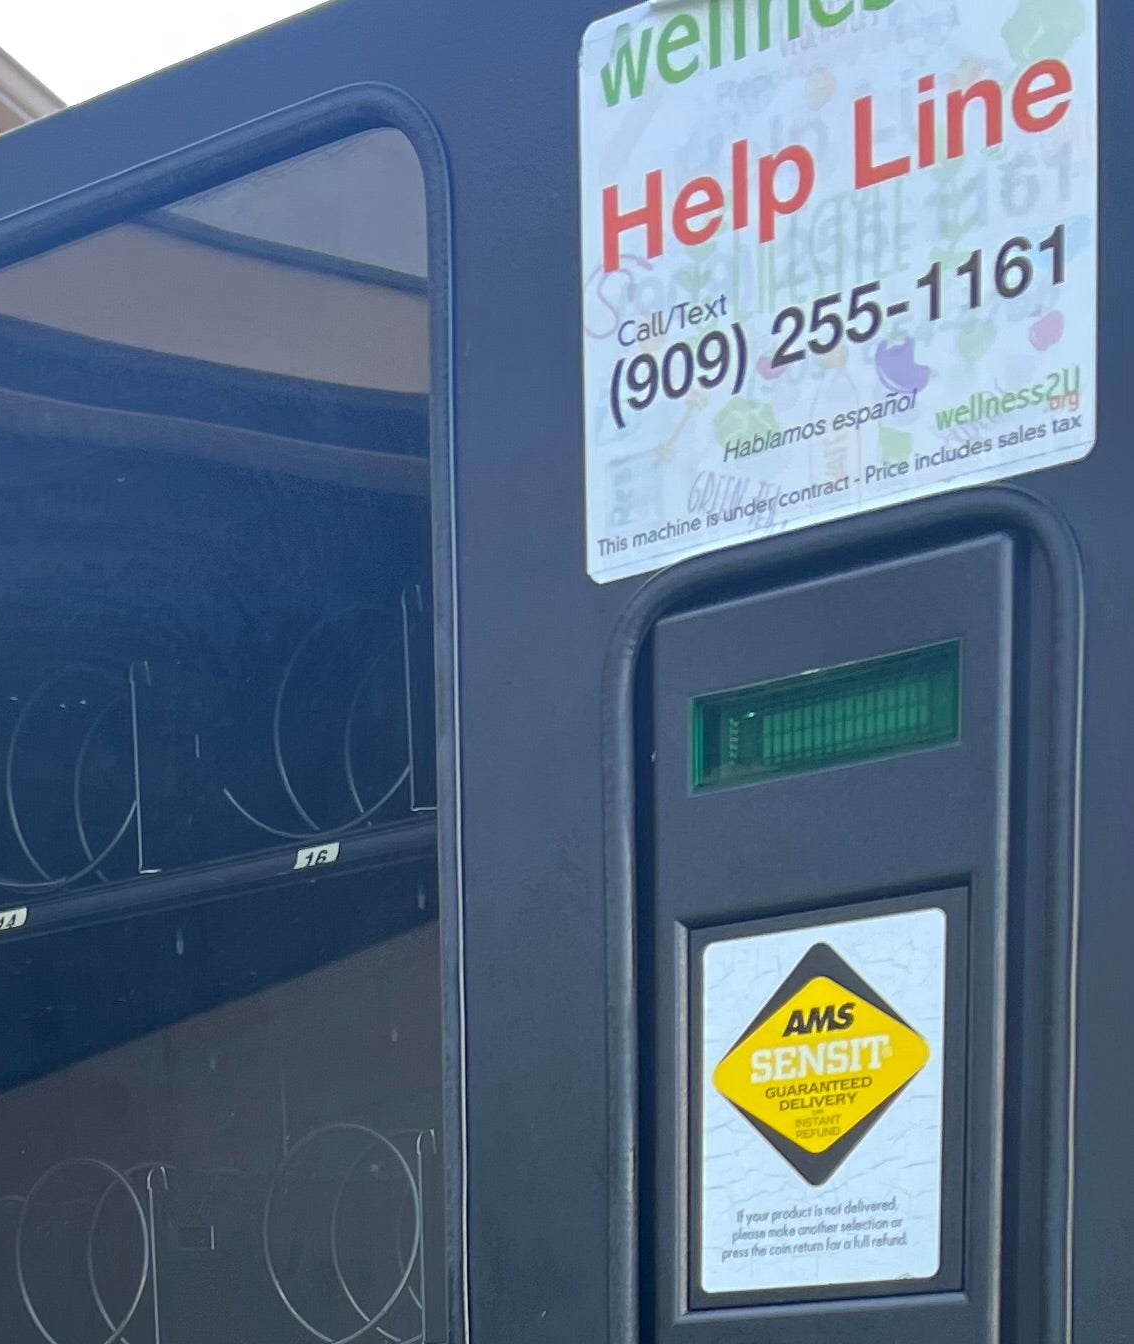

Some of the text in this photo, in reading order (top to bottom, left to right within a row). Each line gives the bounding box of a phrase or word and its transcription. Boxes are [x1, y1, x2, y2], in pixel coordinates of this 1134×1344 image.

[602, 138, 815, 273] Help
[853, 59, 1073, 190] Line
[610, 323, 747, 429] (909)
[771, 224, 1065, 369] 255-1161
[617, 294, 727, 347] Call/Text
[935, 365, 1080, 431] wellness2U
[723, 388, 917, 462] Hablamos español
[597, 535, 628, 557] This
[633, 517, 701, 548] machine
[706, 512, 719, 527] is
[723, 500, 774, 524] under
[778, 475, 850, 508] contract
[866, 459, 908, 485] Price
[915, 437, 992, 471] includes
[998, 424, 1046, 448] sales
[1052, 414, 1082, 434] tax
[305, 849, 327, 865] 16
[782, 1002, 856, 1038] AMS
[751, 1034, 890, 1084] SENSIT
[765, 1077, 873, 1099] GUARANTEED
[779, 1092, 858, 1111] DELIVERY
[795, 1114, 842, 1129] INSTANT
[796, 1126, 842, 1139] REFUND
[732, 1217, 903, 1244] please make another selection or
[737, 1209, 745, 1225] If
[746, 1214, 770, 1226] your
[771, 1206, 812, 1223] product
[814, 1204, 823, 1217] is
[825, 1204, 842, 1216] not
[721, 1248, 749, 1263] press
[751, 1243, 767, 1257] the
[769, 1243, 791, 1255] coin
[793, 1241, 824, 1254] return
[826, 1237, 841, 1251] for
[843, 1240, 851, 1250] a
[853, 1234, 870, 1249] full
